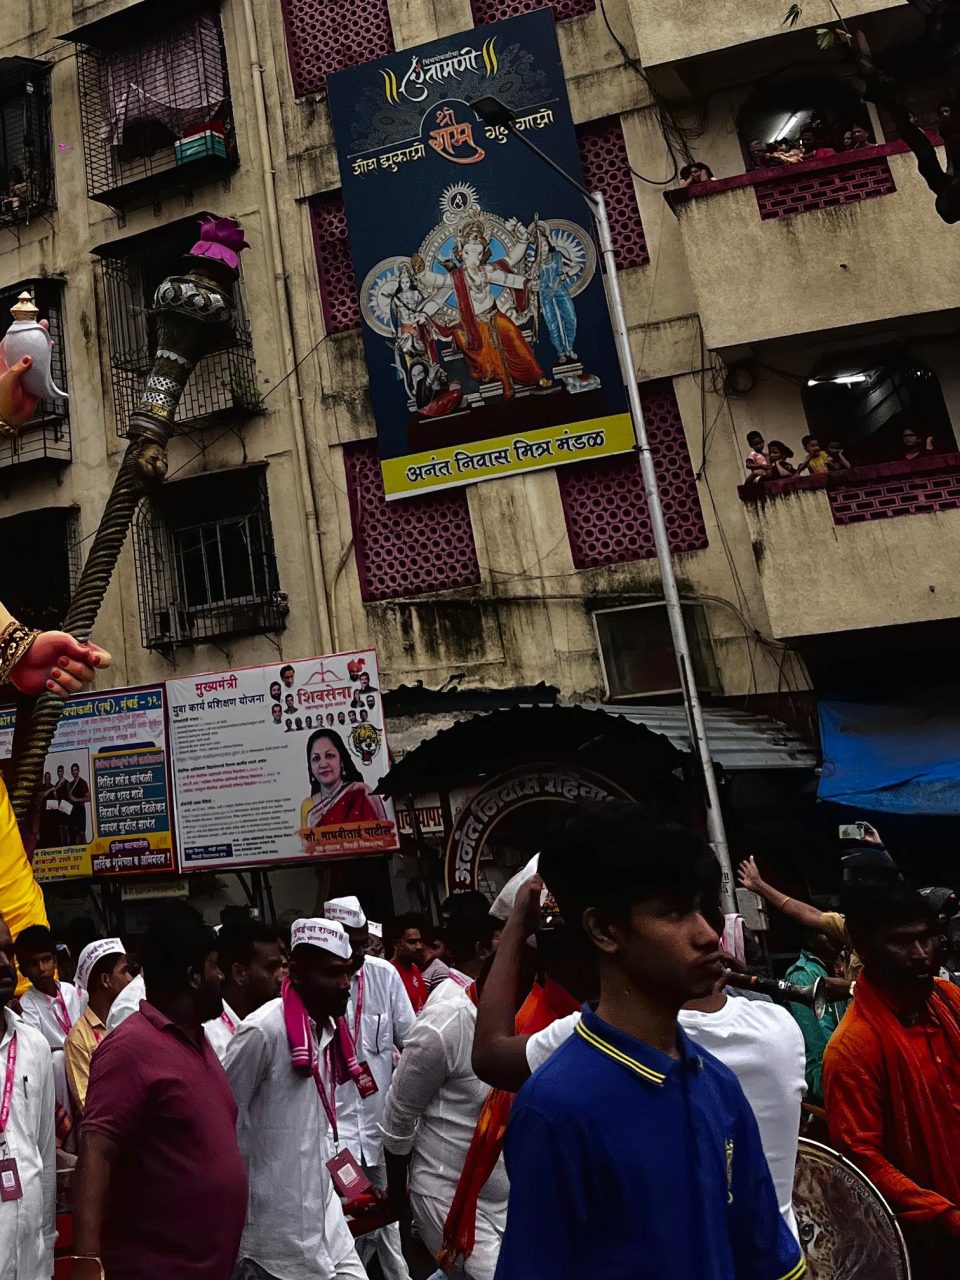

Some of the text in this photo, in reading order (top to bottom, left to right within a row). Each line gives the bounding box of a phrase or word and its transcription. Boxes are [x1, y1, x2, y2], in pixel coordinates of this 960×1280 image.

[436, 106, 457, 127] श्री
[428, 122, 486, 164] राम
[405, 429, 606, 483] अनंत निवास मित्र मंडळ
[194, 674, 239, 698] मुख्यमंत्री
[296, 684, 353, 706] शिवसेना
[172, 703, 188, 718] युवा
[189, 698, 205, 713] कार्य
[207, 696, 241, 711] प्रशिक्षण
[242, 692, 266, 706] योजना
[470, 774, 541, 824] निवास
[364, 822, 392, 837] पाटील
